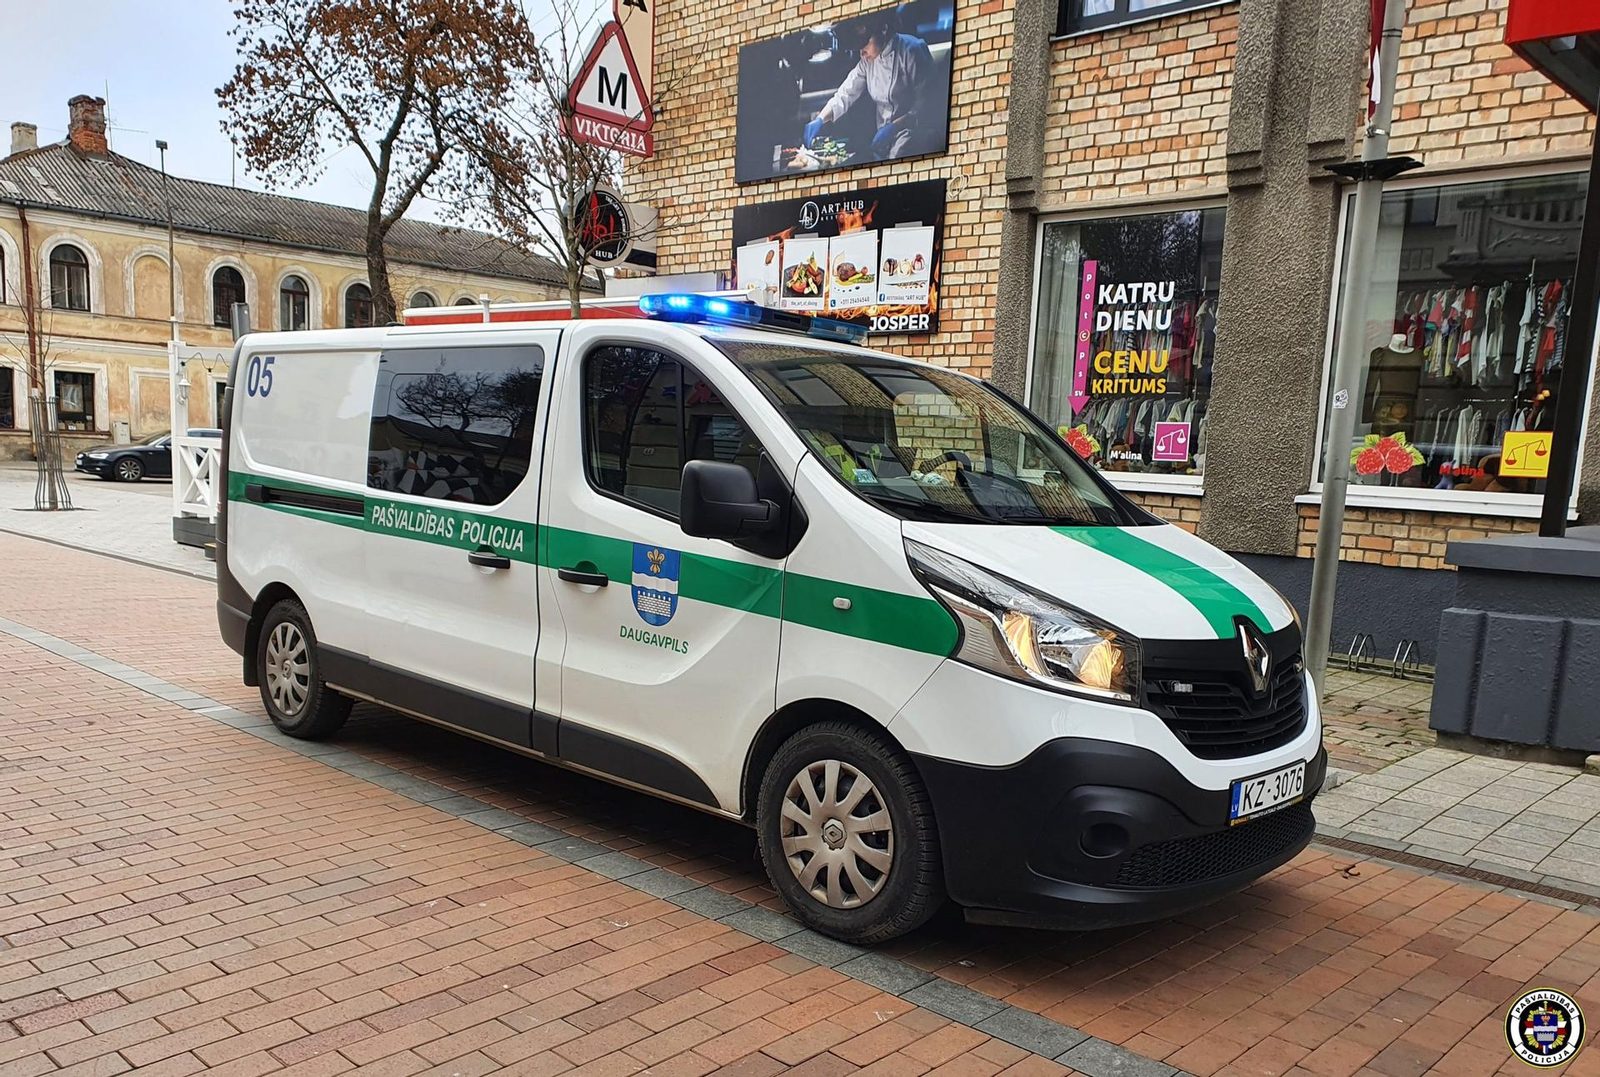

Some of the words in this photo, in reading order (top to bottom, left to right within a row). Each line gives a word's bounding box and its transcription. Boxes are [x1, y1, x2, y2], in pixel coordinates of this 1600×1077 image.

[598, 65, 628, 110] M
[575, 117, 647, 151] VIKTORIA
[821, 203, 841, 214] ART
[843, 200, 864, 211] HUB
[595, 250, 613, 259] HUB
[1098, 281, 1175, 305] KATRU
[869, 314, 930, 331] JOSPER
[1096, 309, 1172, 332] DIENU
[1094, 350, 1169, 374] CENU
[247, 356, 275, 397] 05
[1092, 378, 1167, 394] KRITUMS
[371, 503, 455, 539] PAŠVALDĪBAS
[460, 520, 524, 552] POLICIJA
[619, 625, 689, 654] DAUGAVPILS
[1231, 803, 1239, 813] LV
[1242, 766, 1303, 812] KZ-3076
